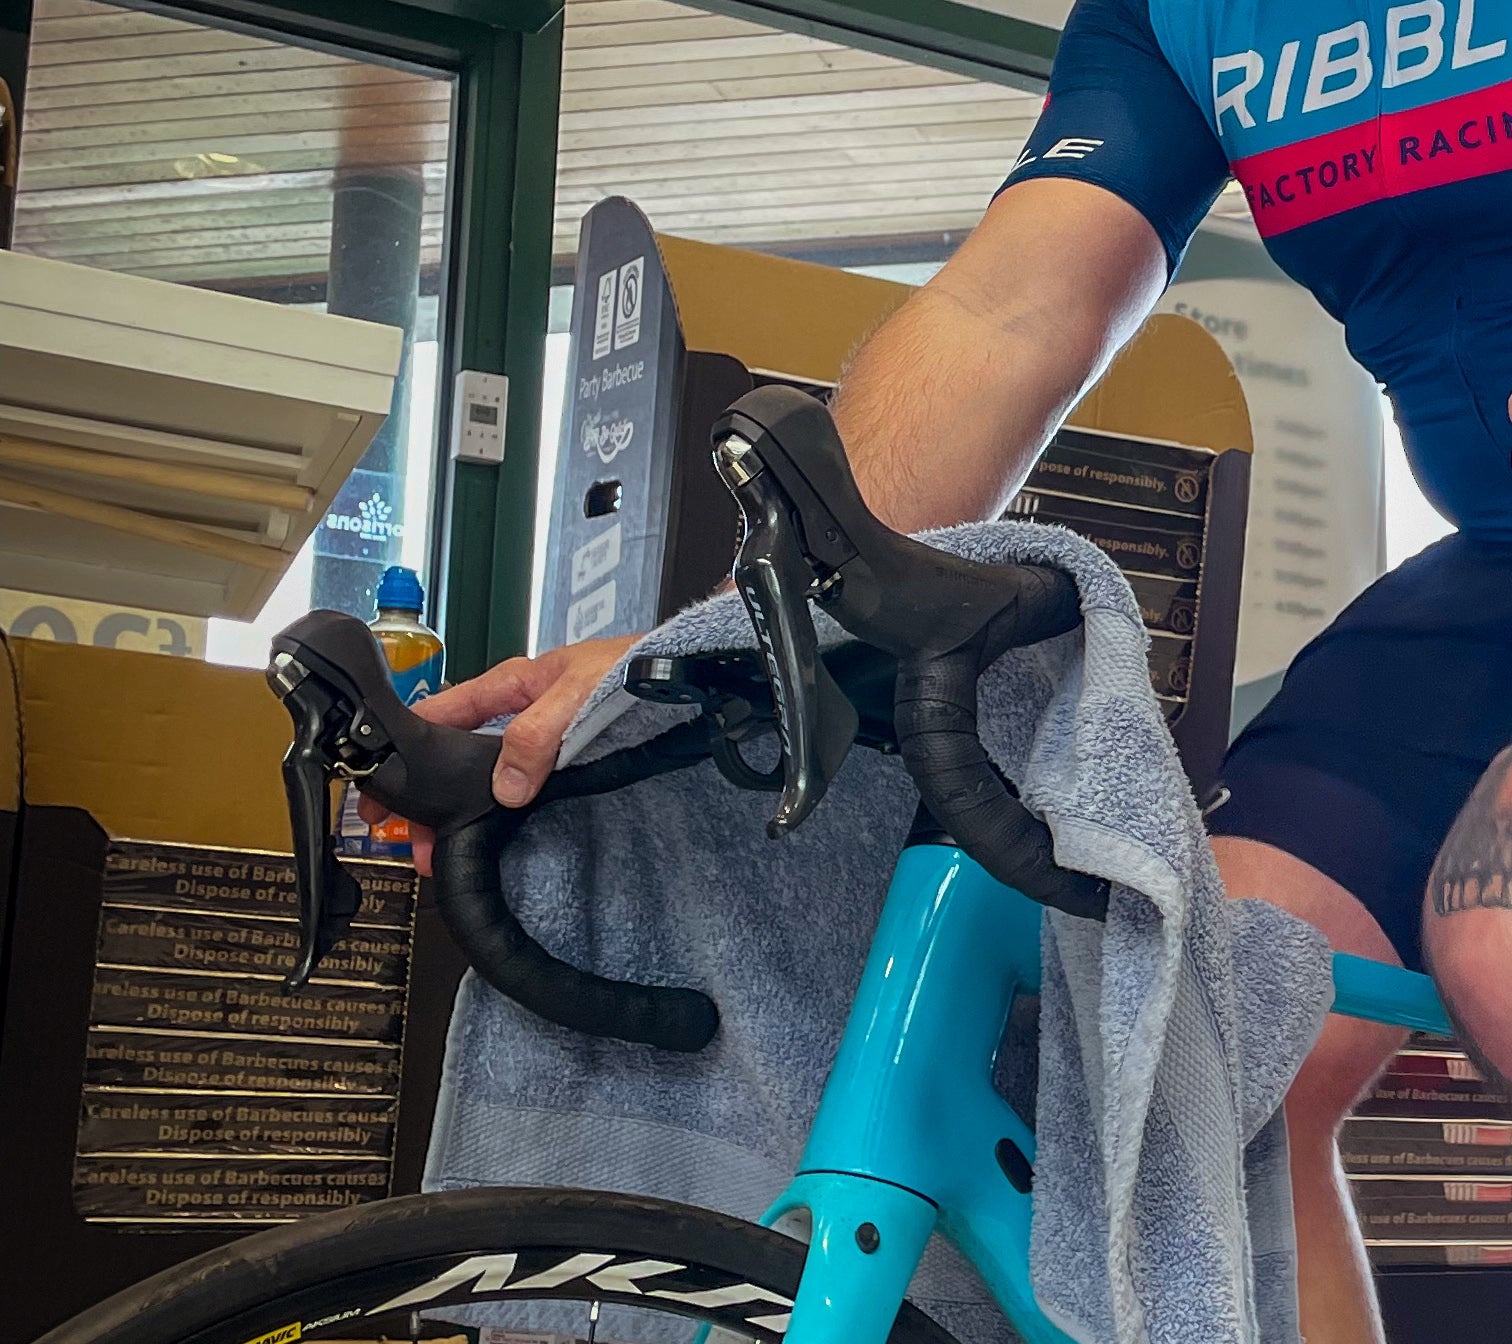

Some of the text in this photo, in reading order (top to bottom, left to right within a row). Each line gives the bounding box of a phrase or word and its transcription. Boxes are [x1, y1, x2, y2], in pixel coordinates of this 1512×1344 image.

[578, 360, 646, 401] Party Barbecue
[745, 585, 793, 757] ULTEGRA
[191, 864, 224, 878] use
[228, 863, 249, 880] of
[175, 879, 250, 900] Dispose
[255, 886, 275, 902] of
[361, 878, 411, 893] auses
[191, 929, 224, 942] use
[227, 928, 249, 944] of
[174, 943, 250, 965] Dispose
[254, 949, 274, 965] of
[164, 988, 198, 1002] use
[201, 988, 224, 1004] of
[226, 989, 322, 1012] Barbecues
[326, 998, 386, 1015] causes
[147, 1003, 361, 1033] Dispose of responsibly
[159, 1050, 193, 1064] use
[197, 1049, 219, 1065] of
[222, 1051, 319, 1071] Barbecues
[323, 1059, 384, 1074] causes
[142, 1066, 220, 1085] Dispose
[223, 1069, 246, 1086] of
[174, 1108, 208, 1121] use
[211, 1106, 233, 1122] of
[236, 1106, 333, 1123] Barbecues
[158, 1124, 372, 1146] Dispose of responsibly
[161, 1172, 196, 1185] use
[200, 1169, 222, 1185] of
[224, 1169, 324, 1186] Barbecues
[326, 1172, 387, 1186] causes
[145, 1188, 361, 1209] Dispose of responsibly
